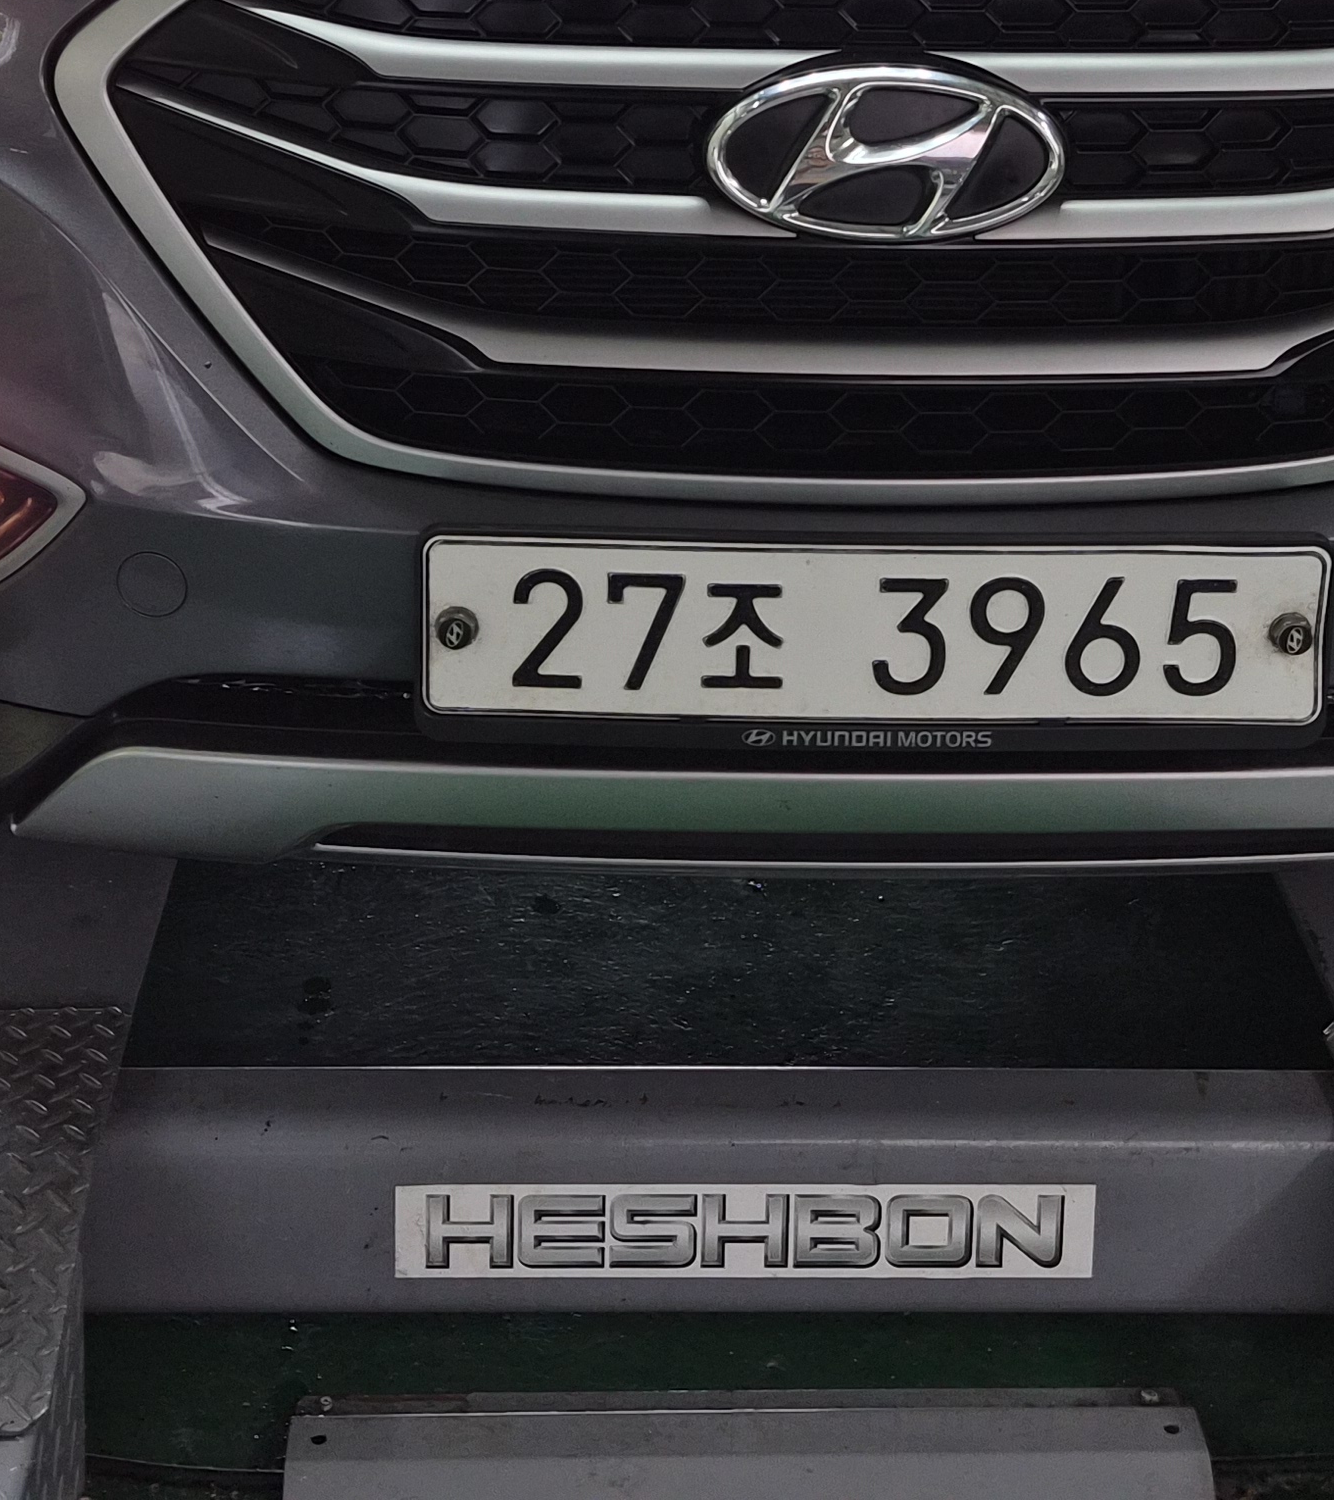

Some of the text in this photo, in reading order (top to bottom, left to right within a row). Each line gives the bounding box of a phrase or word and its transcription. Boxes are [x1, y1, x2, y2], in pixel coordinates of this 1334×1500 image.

[512, 568, 1238, 697] 27조 3965
[781, 730, 992, 748] HYUNDAI MOTORS
[424, 1193, 1066, 1269] HESHBON
